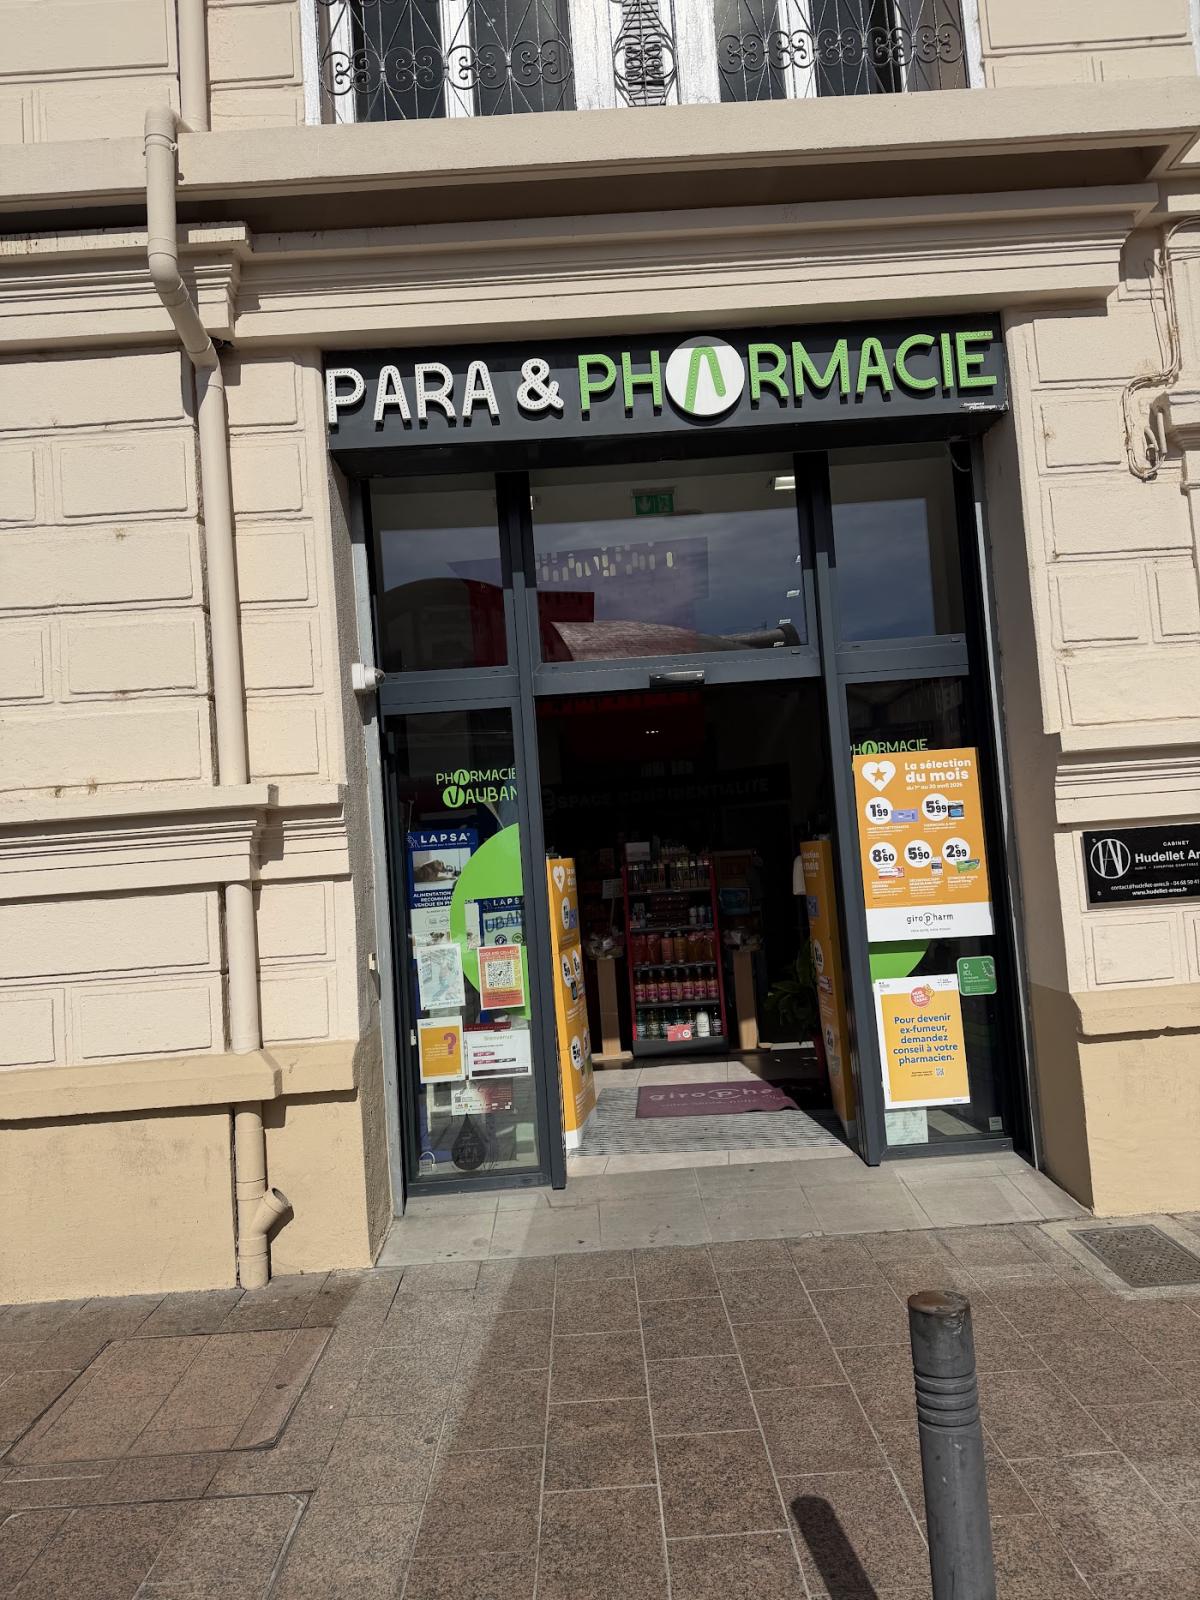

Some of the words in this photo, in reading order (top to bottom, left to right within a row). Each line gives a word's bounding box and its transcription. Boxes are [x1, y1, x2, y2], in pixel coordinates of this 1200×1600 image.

[325, 360, 500, 424] PARA
[516, 358, 565, 412] &
[577, 330, 998, 413] PHARMACIE
[904, 762, 917, 771] La
[919, 758, 972, 769] sélection
[435, 767, 517, 786] PHARMACIE
[905, 771, 927, 783] du
[929, 767, 969, 781] mois
[442, 785, 519, 808] VAUBAN
[1134, 850, 1186, 864] Hudellet
[906, 912, 954, 926] giropharm
[894, 1016, 915, 1025] Pour
[917, 1012, 952, 1023] devenir
[899, 1023, 948, 1034] ex-fumeur,
[900, 1033, 948, 1044] demandez
[893, 1045, 925, 1055] conseil
[926, 1043, 932, 1052] à
[933, 1043, 959, 1053] votre
[898, 1054, 955, 1067] pharmacien.
